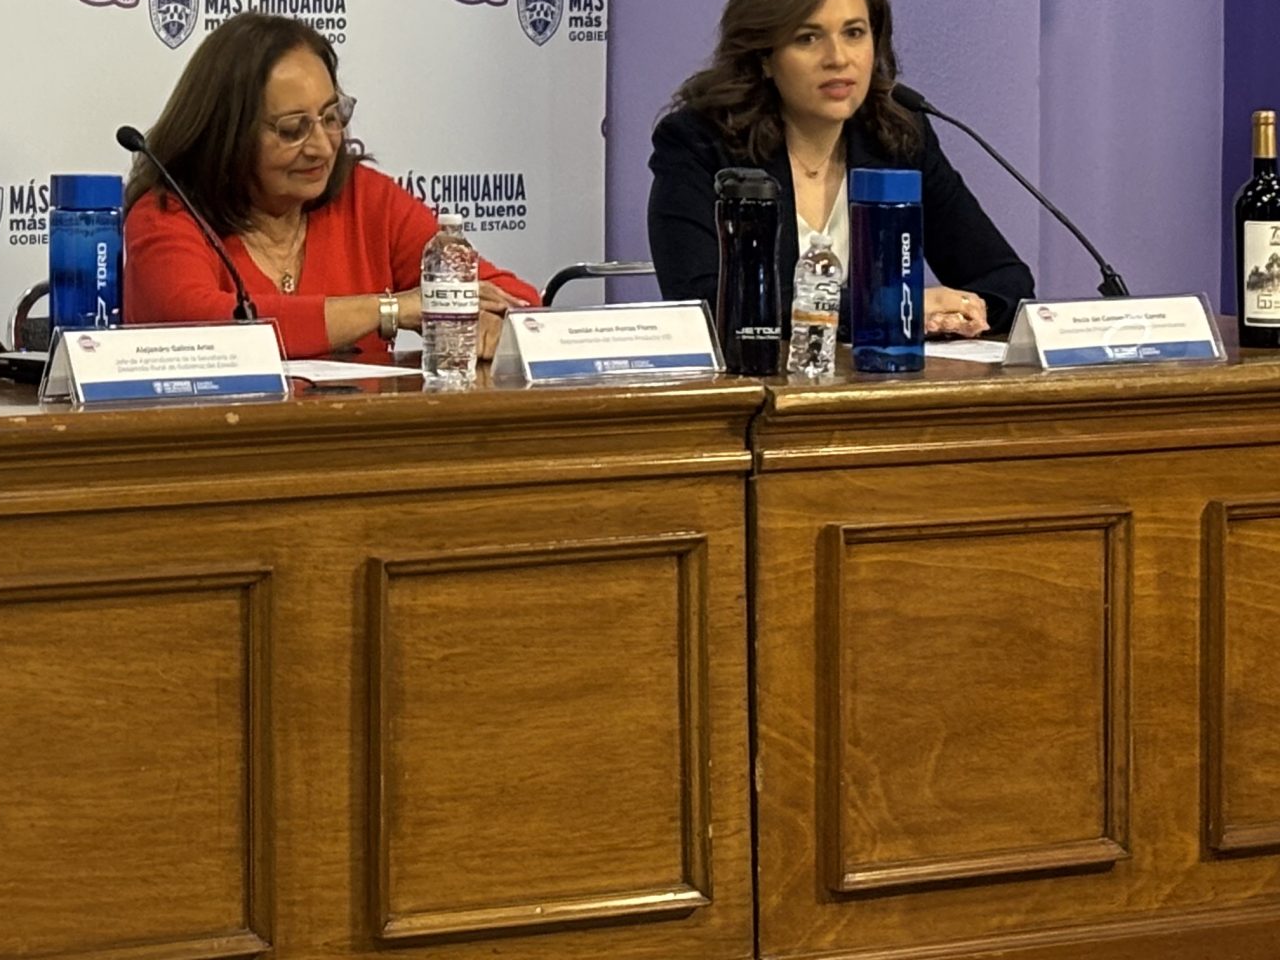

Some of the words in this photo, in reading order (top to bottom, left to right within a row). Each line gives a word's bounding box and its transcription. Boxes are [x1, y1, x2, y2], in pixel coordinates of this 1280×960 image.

[569, 12, 601, 28] más
[10, 179, 49, 214] MÁS
[431, 174, 526, 202] CHIHUAHUA
[475, 202, 526, 217] bueno
[10, 214, 46, 231] más
[481, 220, 526, 231] ESTADO
[97, 242, 107, 290] TORO
[901, 233, 910, 277] TORO
